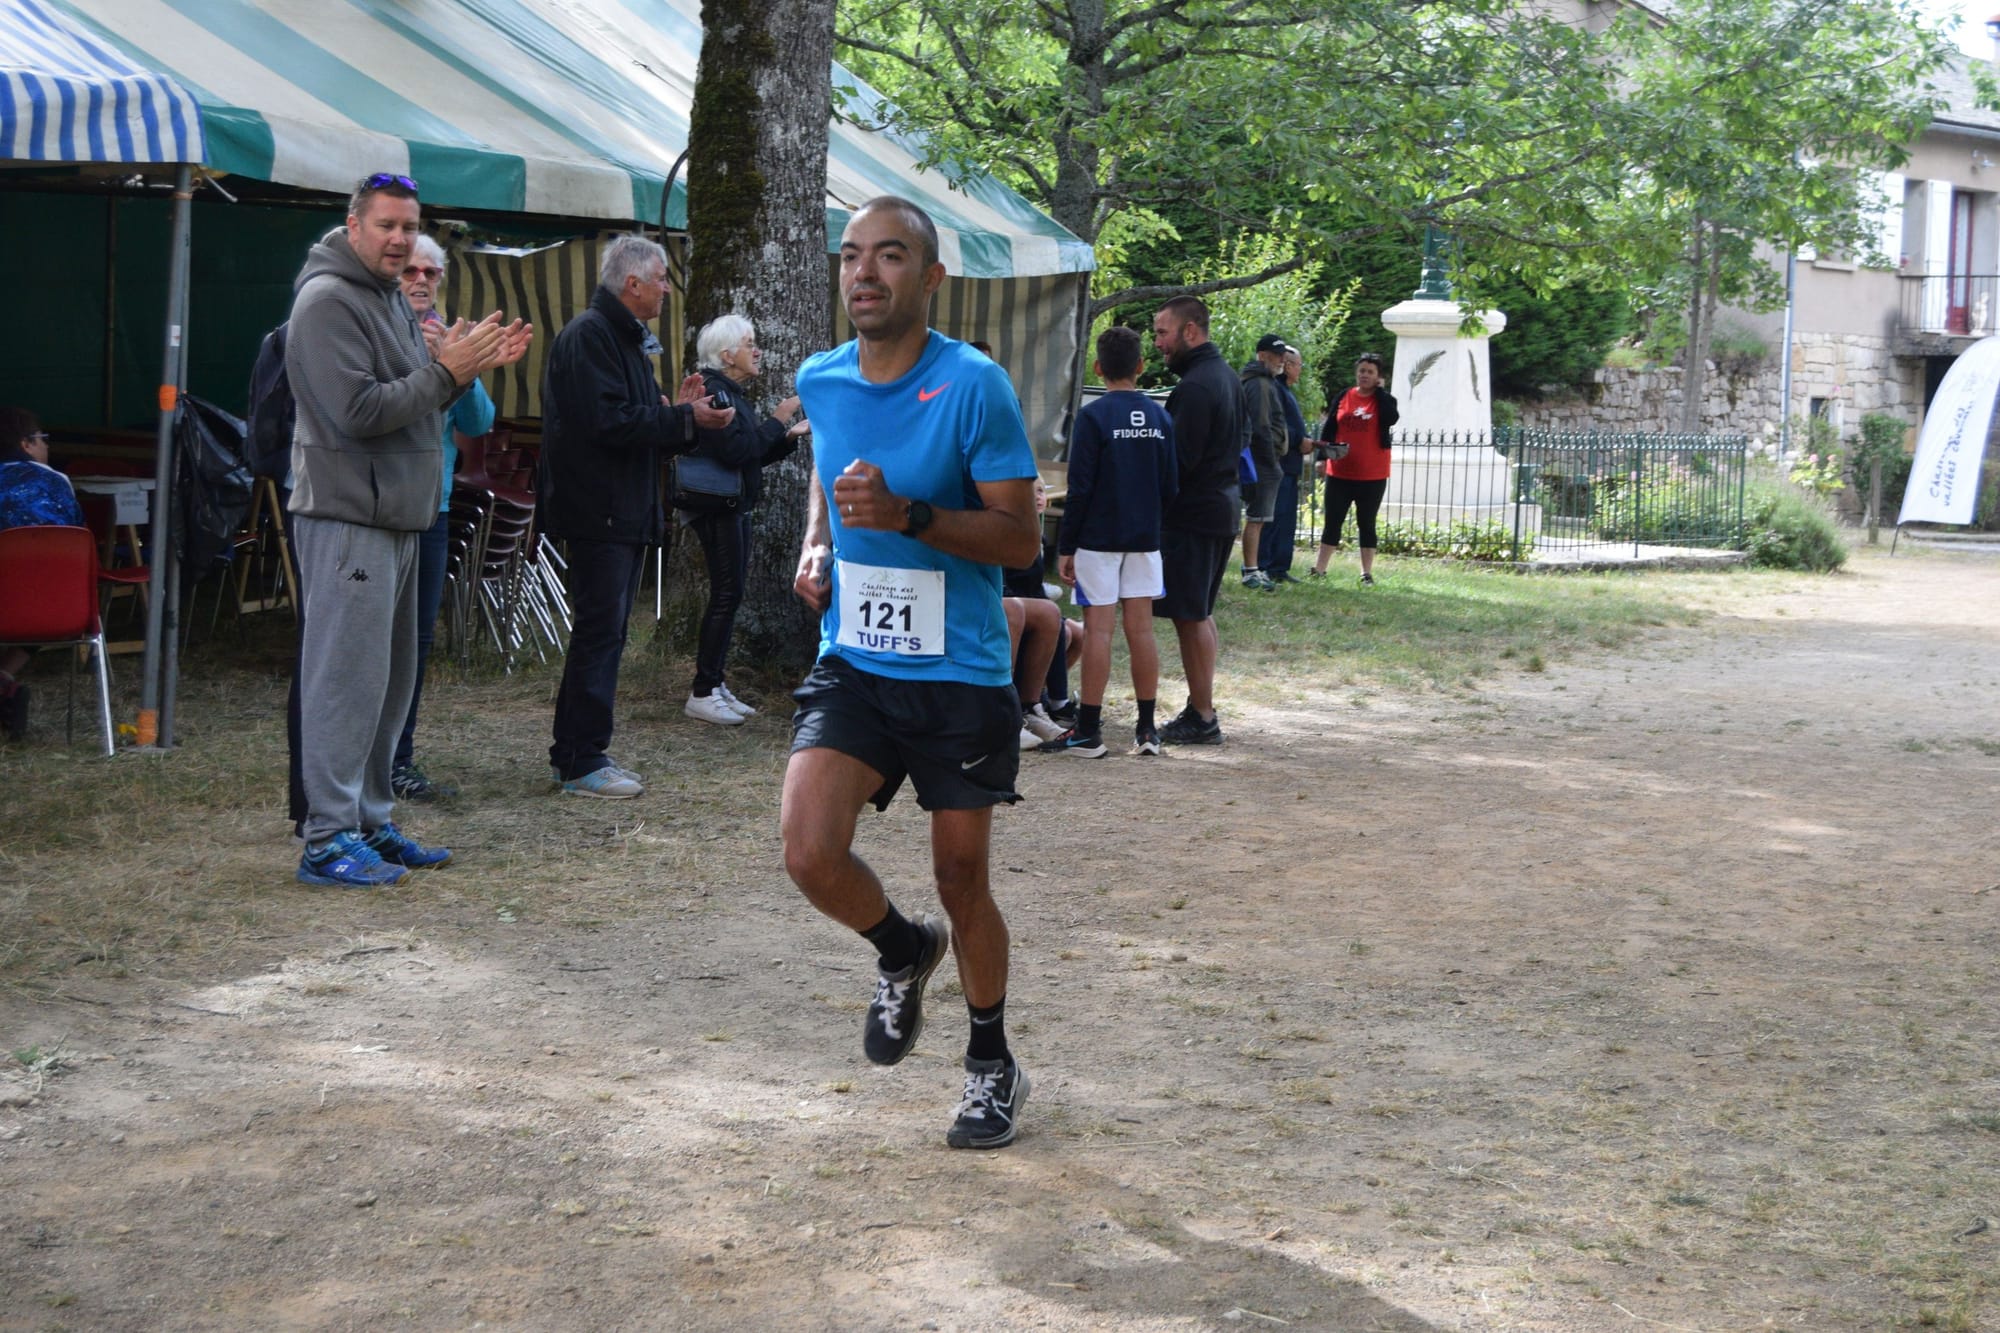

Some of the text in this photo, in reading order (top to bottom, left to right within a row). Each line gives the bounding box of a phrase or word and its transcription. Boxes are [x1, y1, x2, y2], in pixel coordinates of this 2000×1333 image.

[1113, 428, 1165, 440] FIDUCIAL
[1929, 436, 1954, 498] Chall
[861, 582, 915, 594] Challenge des
[859, 600, 912, 632] 121
[856, 631, 922, 651] TUFF'S
